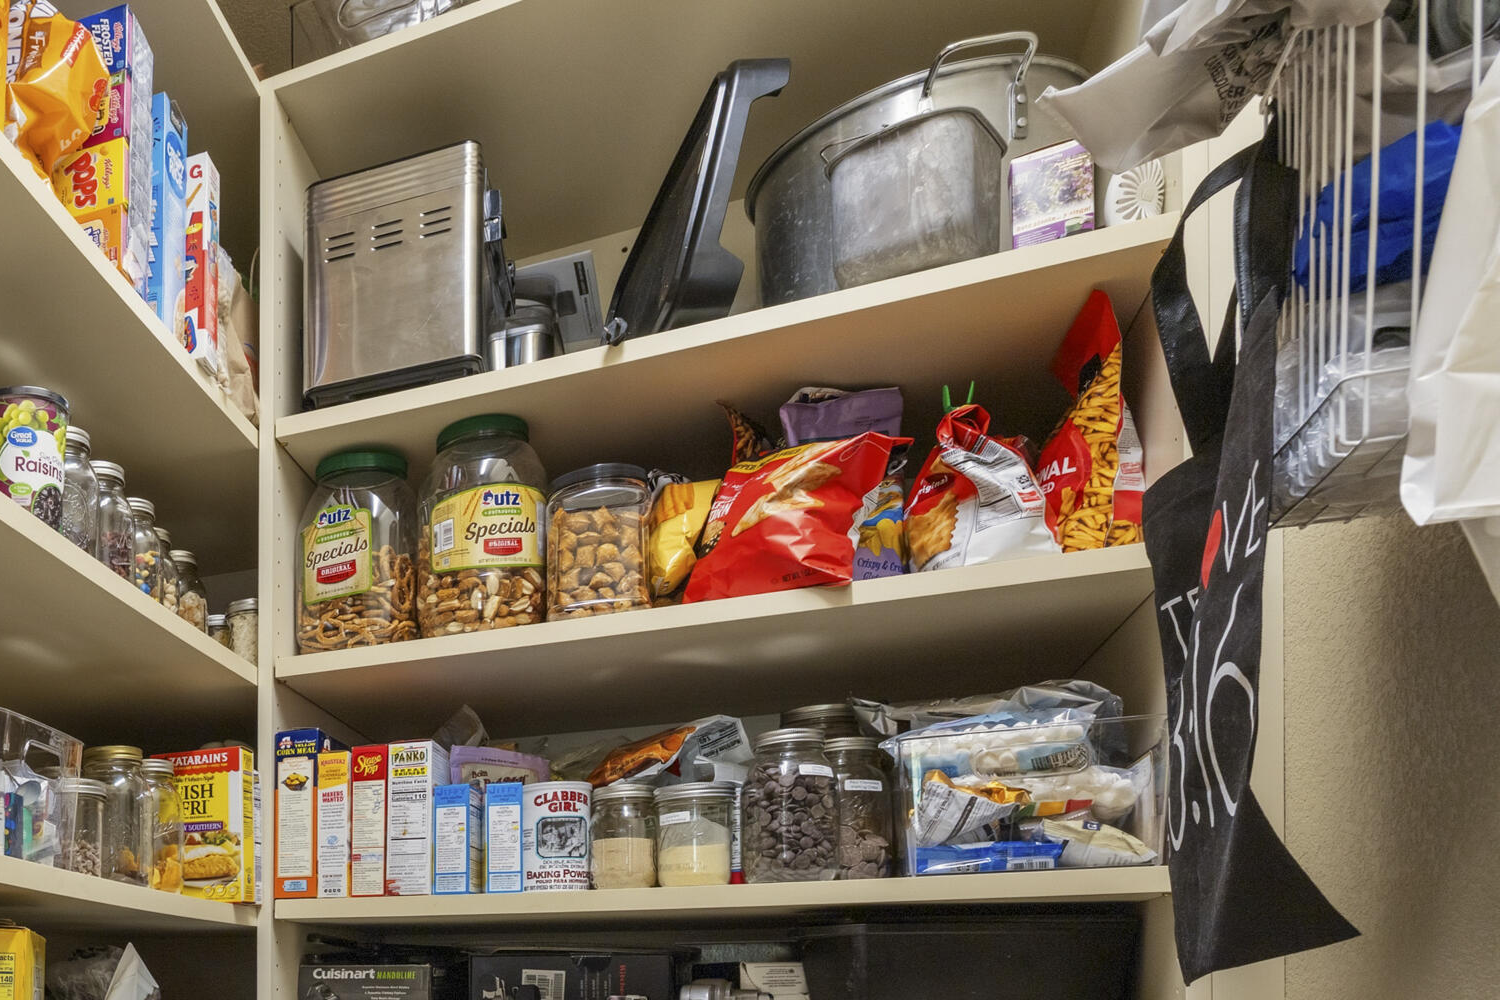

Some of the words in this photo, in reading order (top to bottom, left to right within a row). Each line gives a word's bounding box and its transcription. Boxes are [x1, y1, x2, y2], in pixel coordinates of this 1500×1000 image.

[100, 19, 113, 66] FROSTED
[63, 152, 98, 209] POPS
[15, 456, 62, 483] Raisins
[494, 492, 520, 505] utz
[326, 507, 351, 525] utz
[465, 517, 536, 541] Specials
[489, 540, 519, 549] ORIGINAL
[306, 537, 368, 569] Specials
[321, 564, 351, 576] ORIGINAL
[857, 558, 881, 571] Crispy
[882, 560, 889, 569] &
[276, 748, 296, 756] CORN
[297, 747, 317, 755] MEAL
[393, 752, 426, 762] PANKO
[354, 755, 382, 773] Stove
[363, 765, 378, 776] Top
[534, 791, 588, 806] CLABBER
[548, 802, 579, 813] GIRL
[188, 823, 222, 831] SOUTHERN
[526, 871, 561, 879] BAKING
[313, 967, 375, 981] Cuisinart
